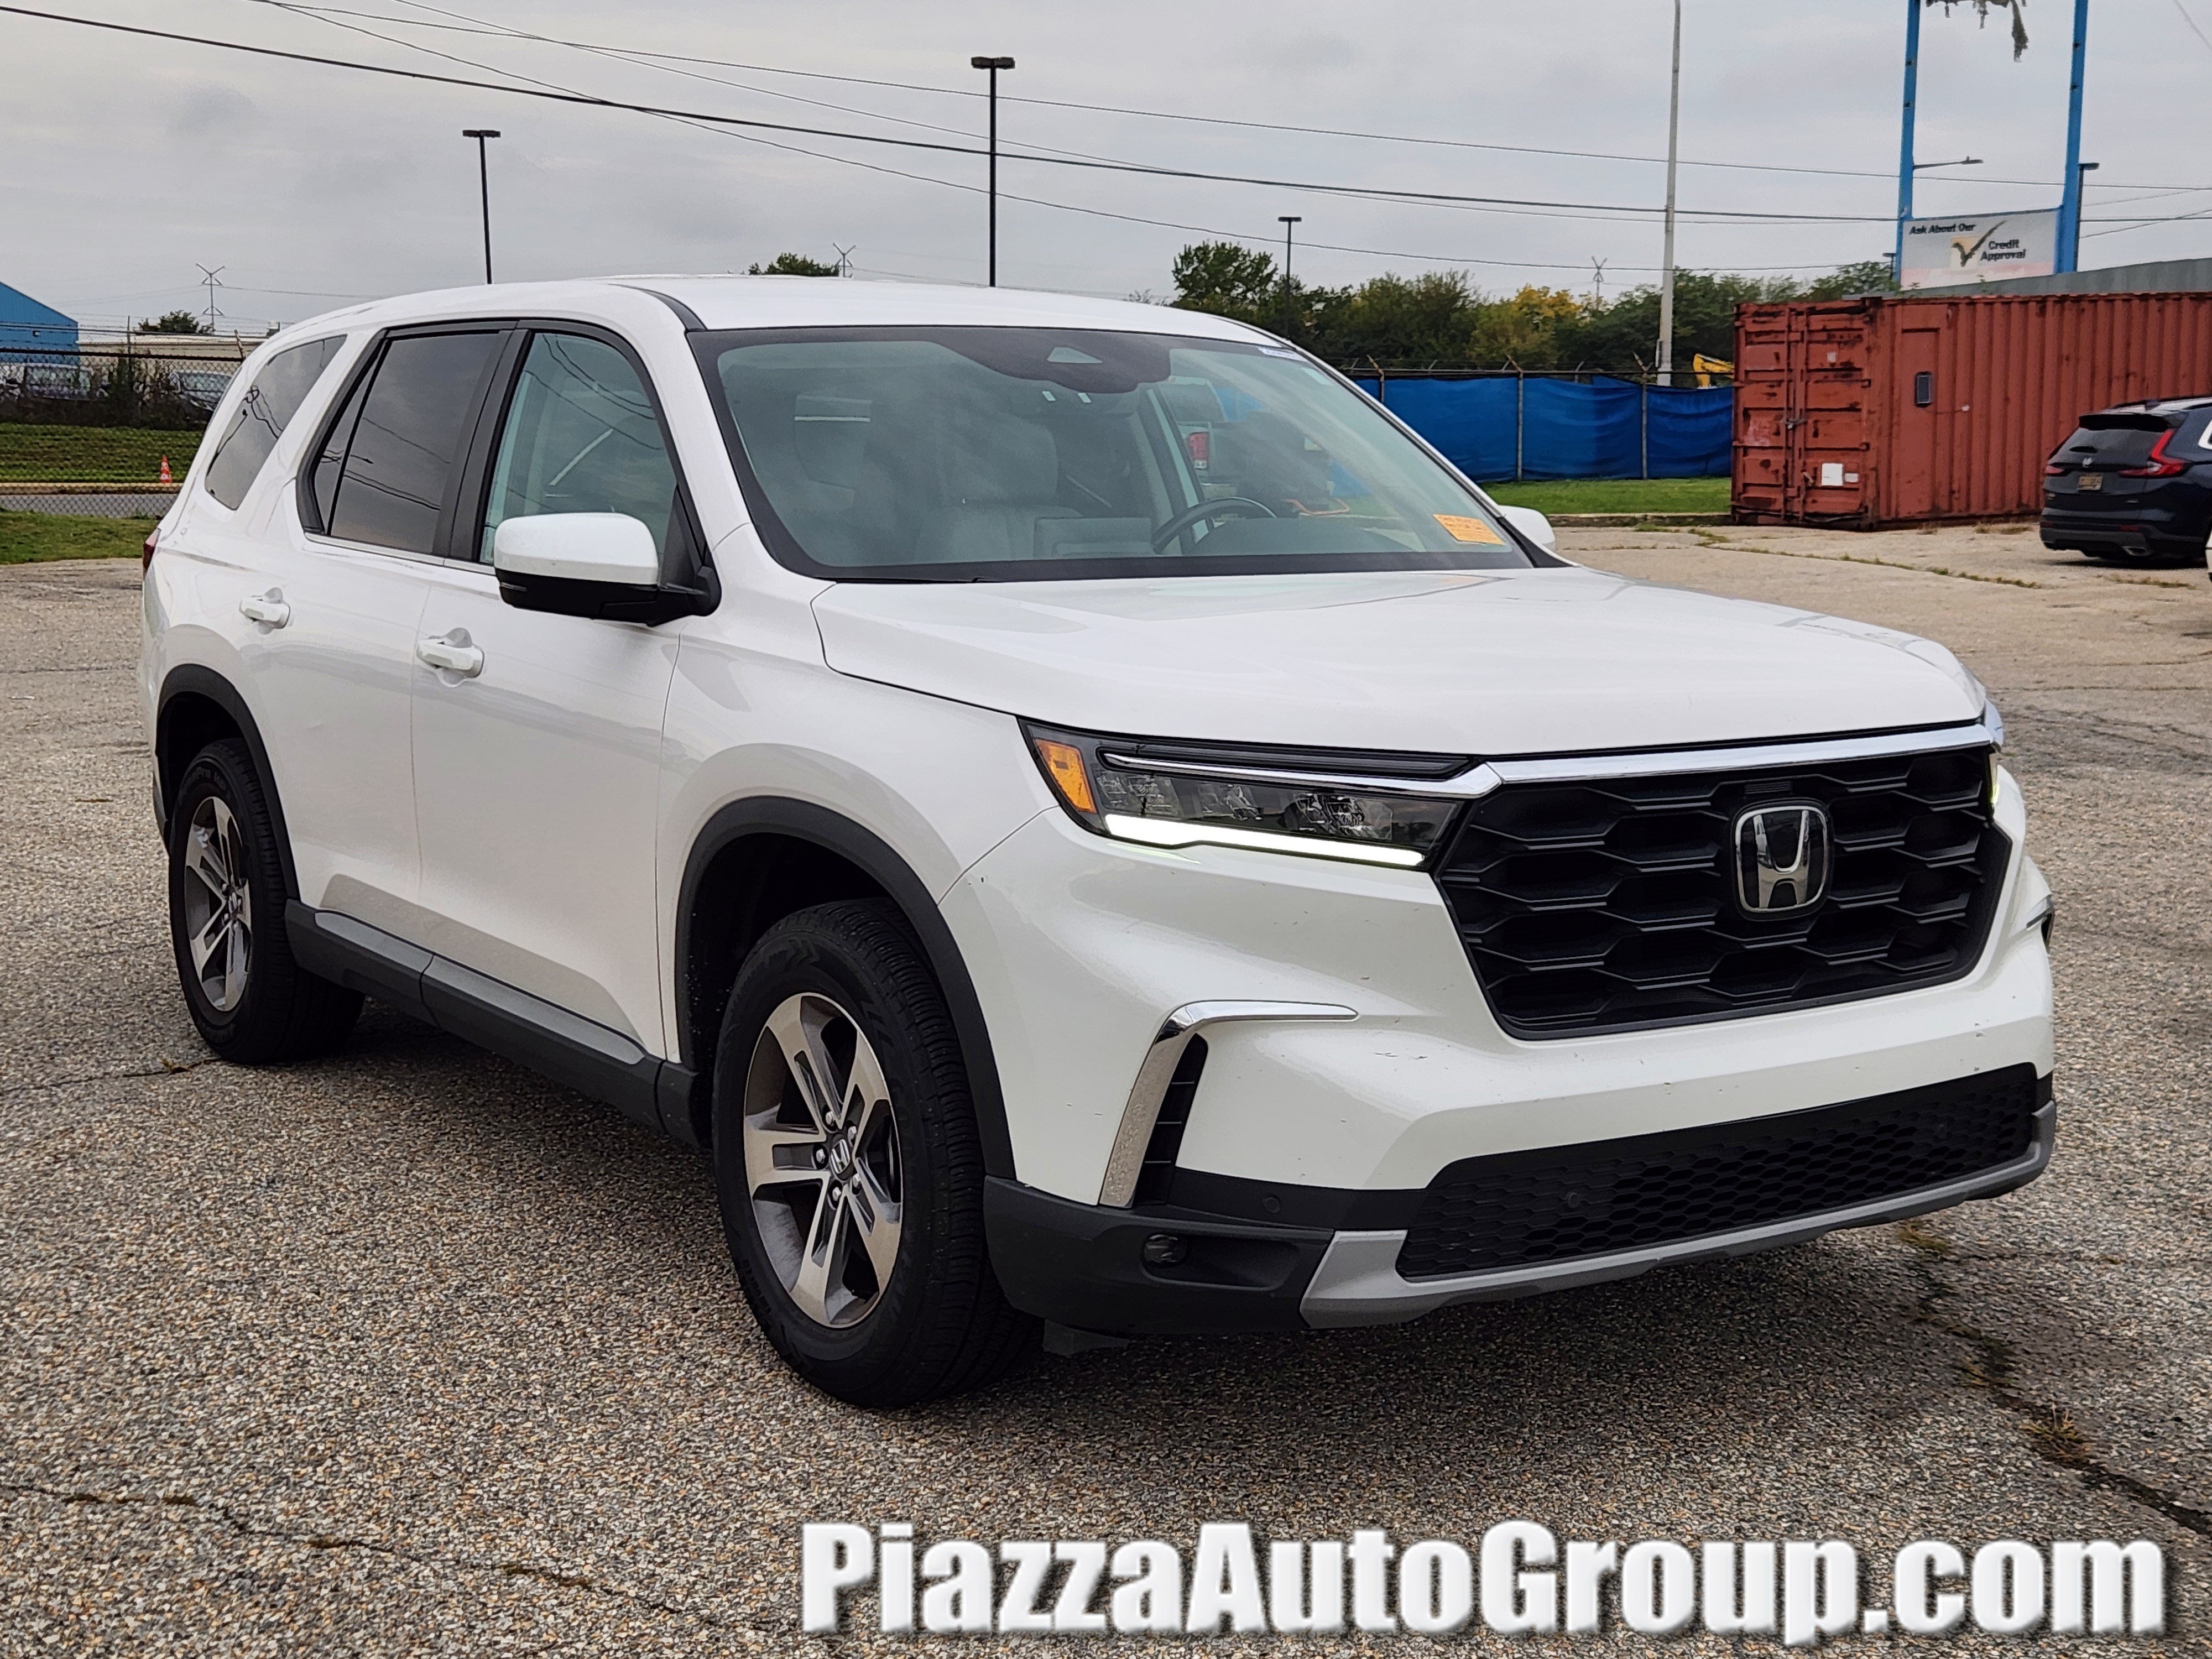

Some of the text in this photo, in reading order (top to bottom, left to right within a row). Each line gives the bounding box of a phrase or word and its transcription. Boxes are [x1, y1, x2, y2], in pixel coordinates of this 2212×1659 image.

[1909, 223, 1976, 234] Ask About Our
[1988, 239, 2020, 250] Credit
[1980, 248, 2026, 262] Approval
